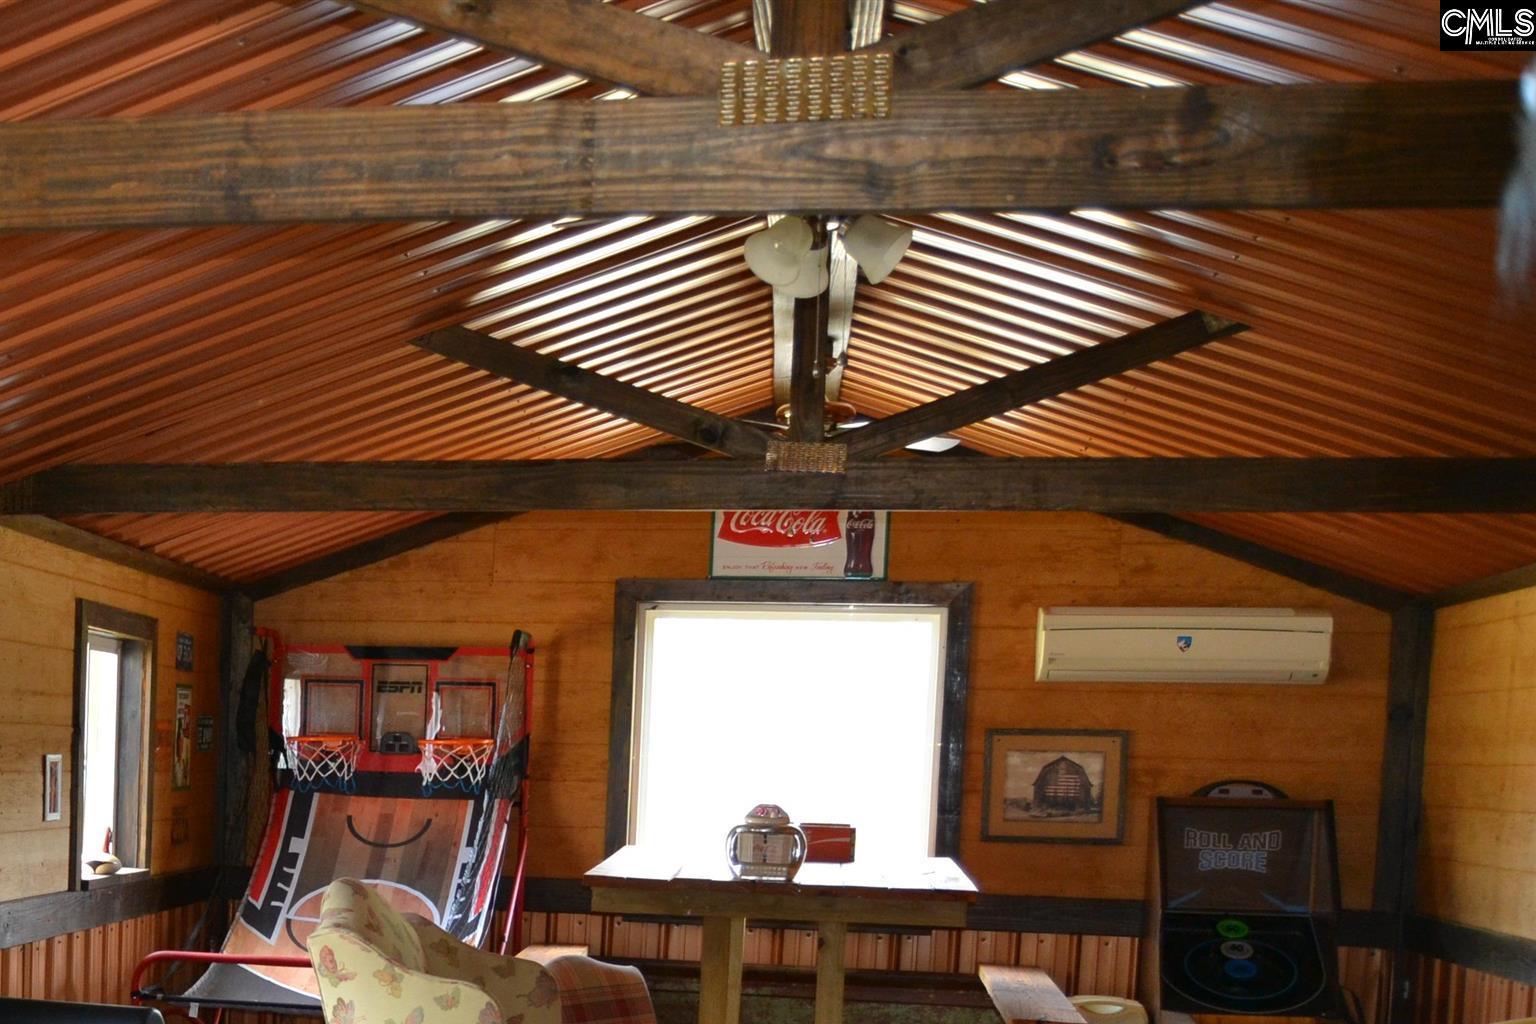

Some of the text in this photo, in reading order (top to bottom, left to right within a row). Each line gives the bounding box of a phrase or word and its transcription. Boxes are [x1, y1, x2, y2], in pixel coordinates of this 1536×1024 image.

[376, 680, 423, 693] ESPN
[1184, 827, 1282, 851] ROLL AND
[1199, 849, 1267, 874] SCORE
